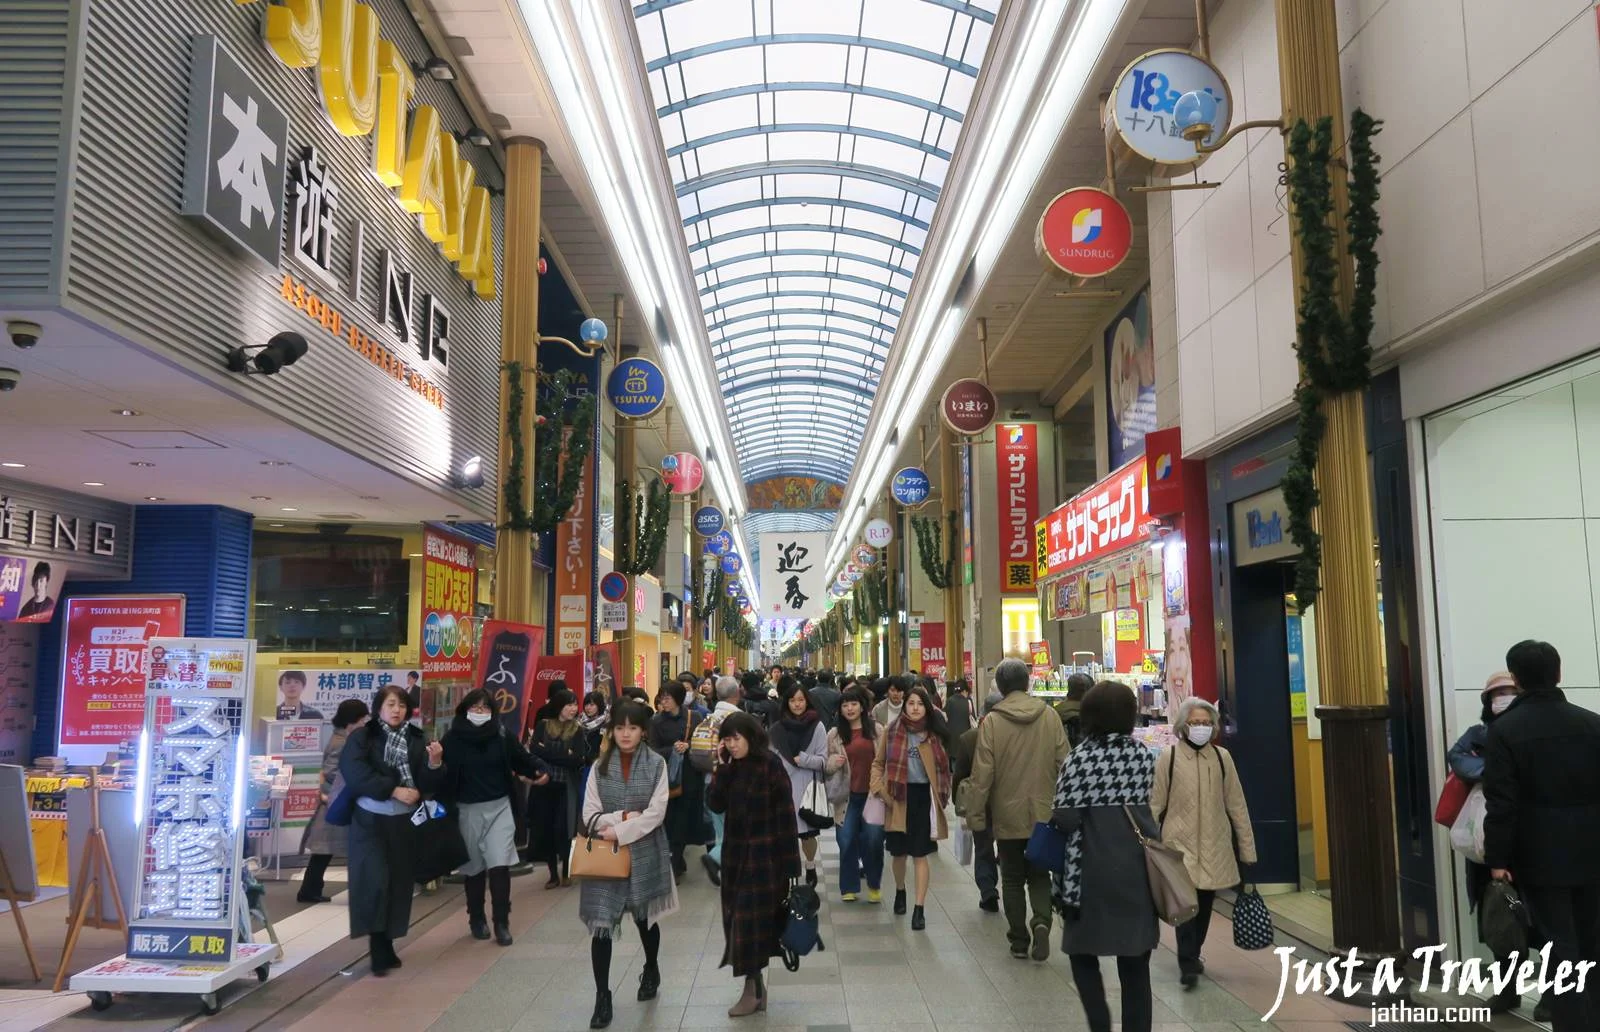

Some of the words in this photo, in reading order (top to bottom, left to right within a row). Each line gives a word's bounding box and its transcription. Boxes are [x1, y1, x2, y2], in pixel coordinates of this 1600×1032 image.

[234, 0, 496, 300] UTAYA
[217, 92, 278, 230] 本
[1059, 247, 1115, 260] SUNDRUG
[615, 395, 657, 404] TSUTAYA
[952, 400, 989, 412] いまい
[905, 477, 928, 485] フラワー
[1008, 453, 1028, 558] サンドラッグ
[1066, 472, 1136, 561] サンドラッグ
[869, 527, 890, 539] R.P
[776, 541, 814, 609] 迎春
[1009, 564, 1031, 586] 薬
[425, 559, 474, 615] 買取ります!
[90, 607, 121, 615] TSUTAYA
[425, 623, 440, 646] スマホ
[563, 631, 582, 640] DVD
[566, 641, 579, 649] CD
[922, 647, 945, 661] SAL
[87, 675, 144, 686] キャンペー
[318, 672, 393, 691] 林部智史
[149, 697, 226, 920] スマホ修理
